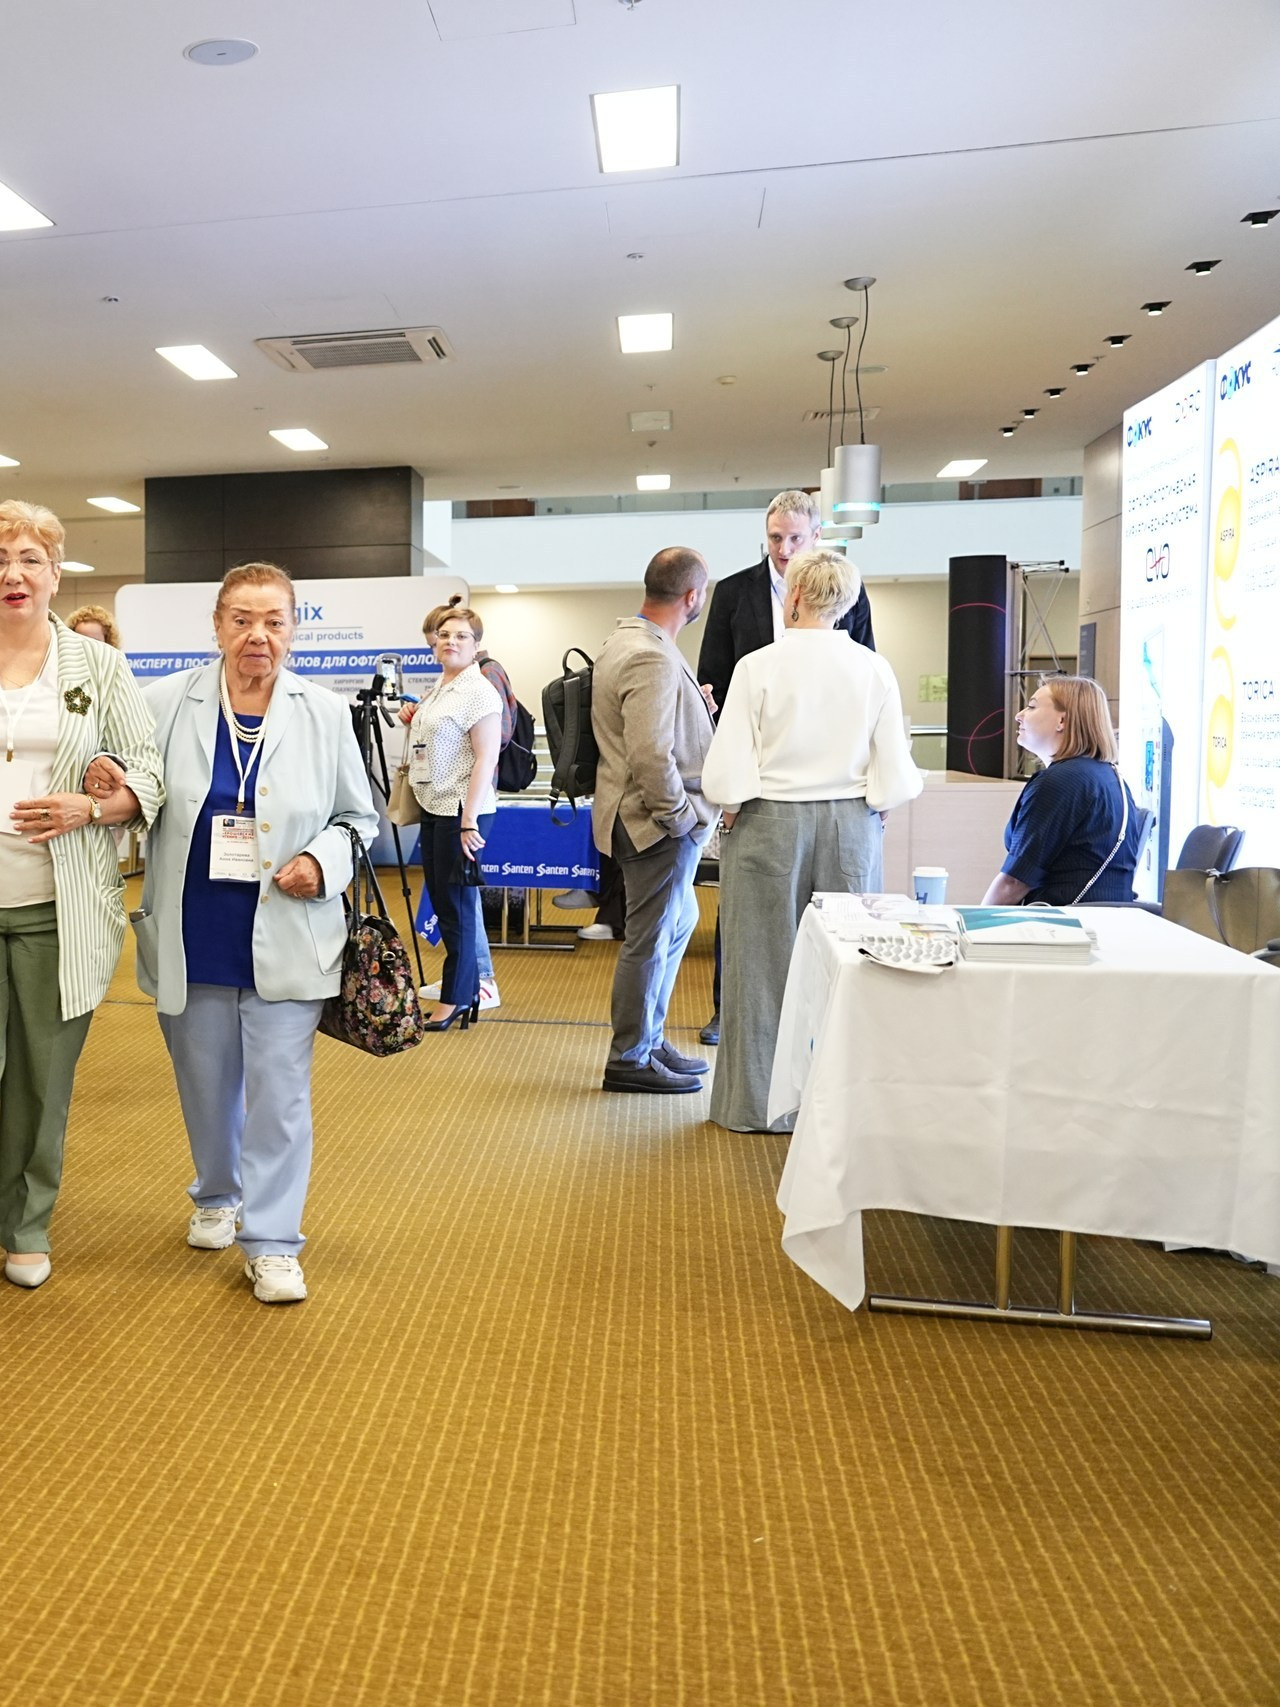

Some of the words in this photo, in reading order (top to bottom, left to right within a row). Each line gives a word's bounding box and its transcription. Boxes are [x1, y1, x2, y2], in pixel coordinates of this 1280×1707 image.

[316, 630, 364, 642] products
[175, 658, 182, 669] В
[321, 656, 347, 669] ДЛЯ
[501, 862, 533, 876] Santen
[536, 863, 569, 877] Santen
